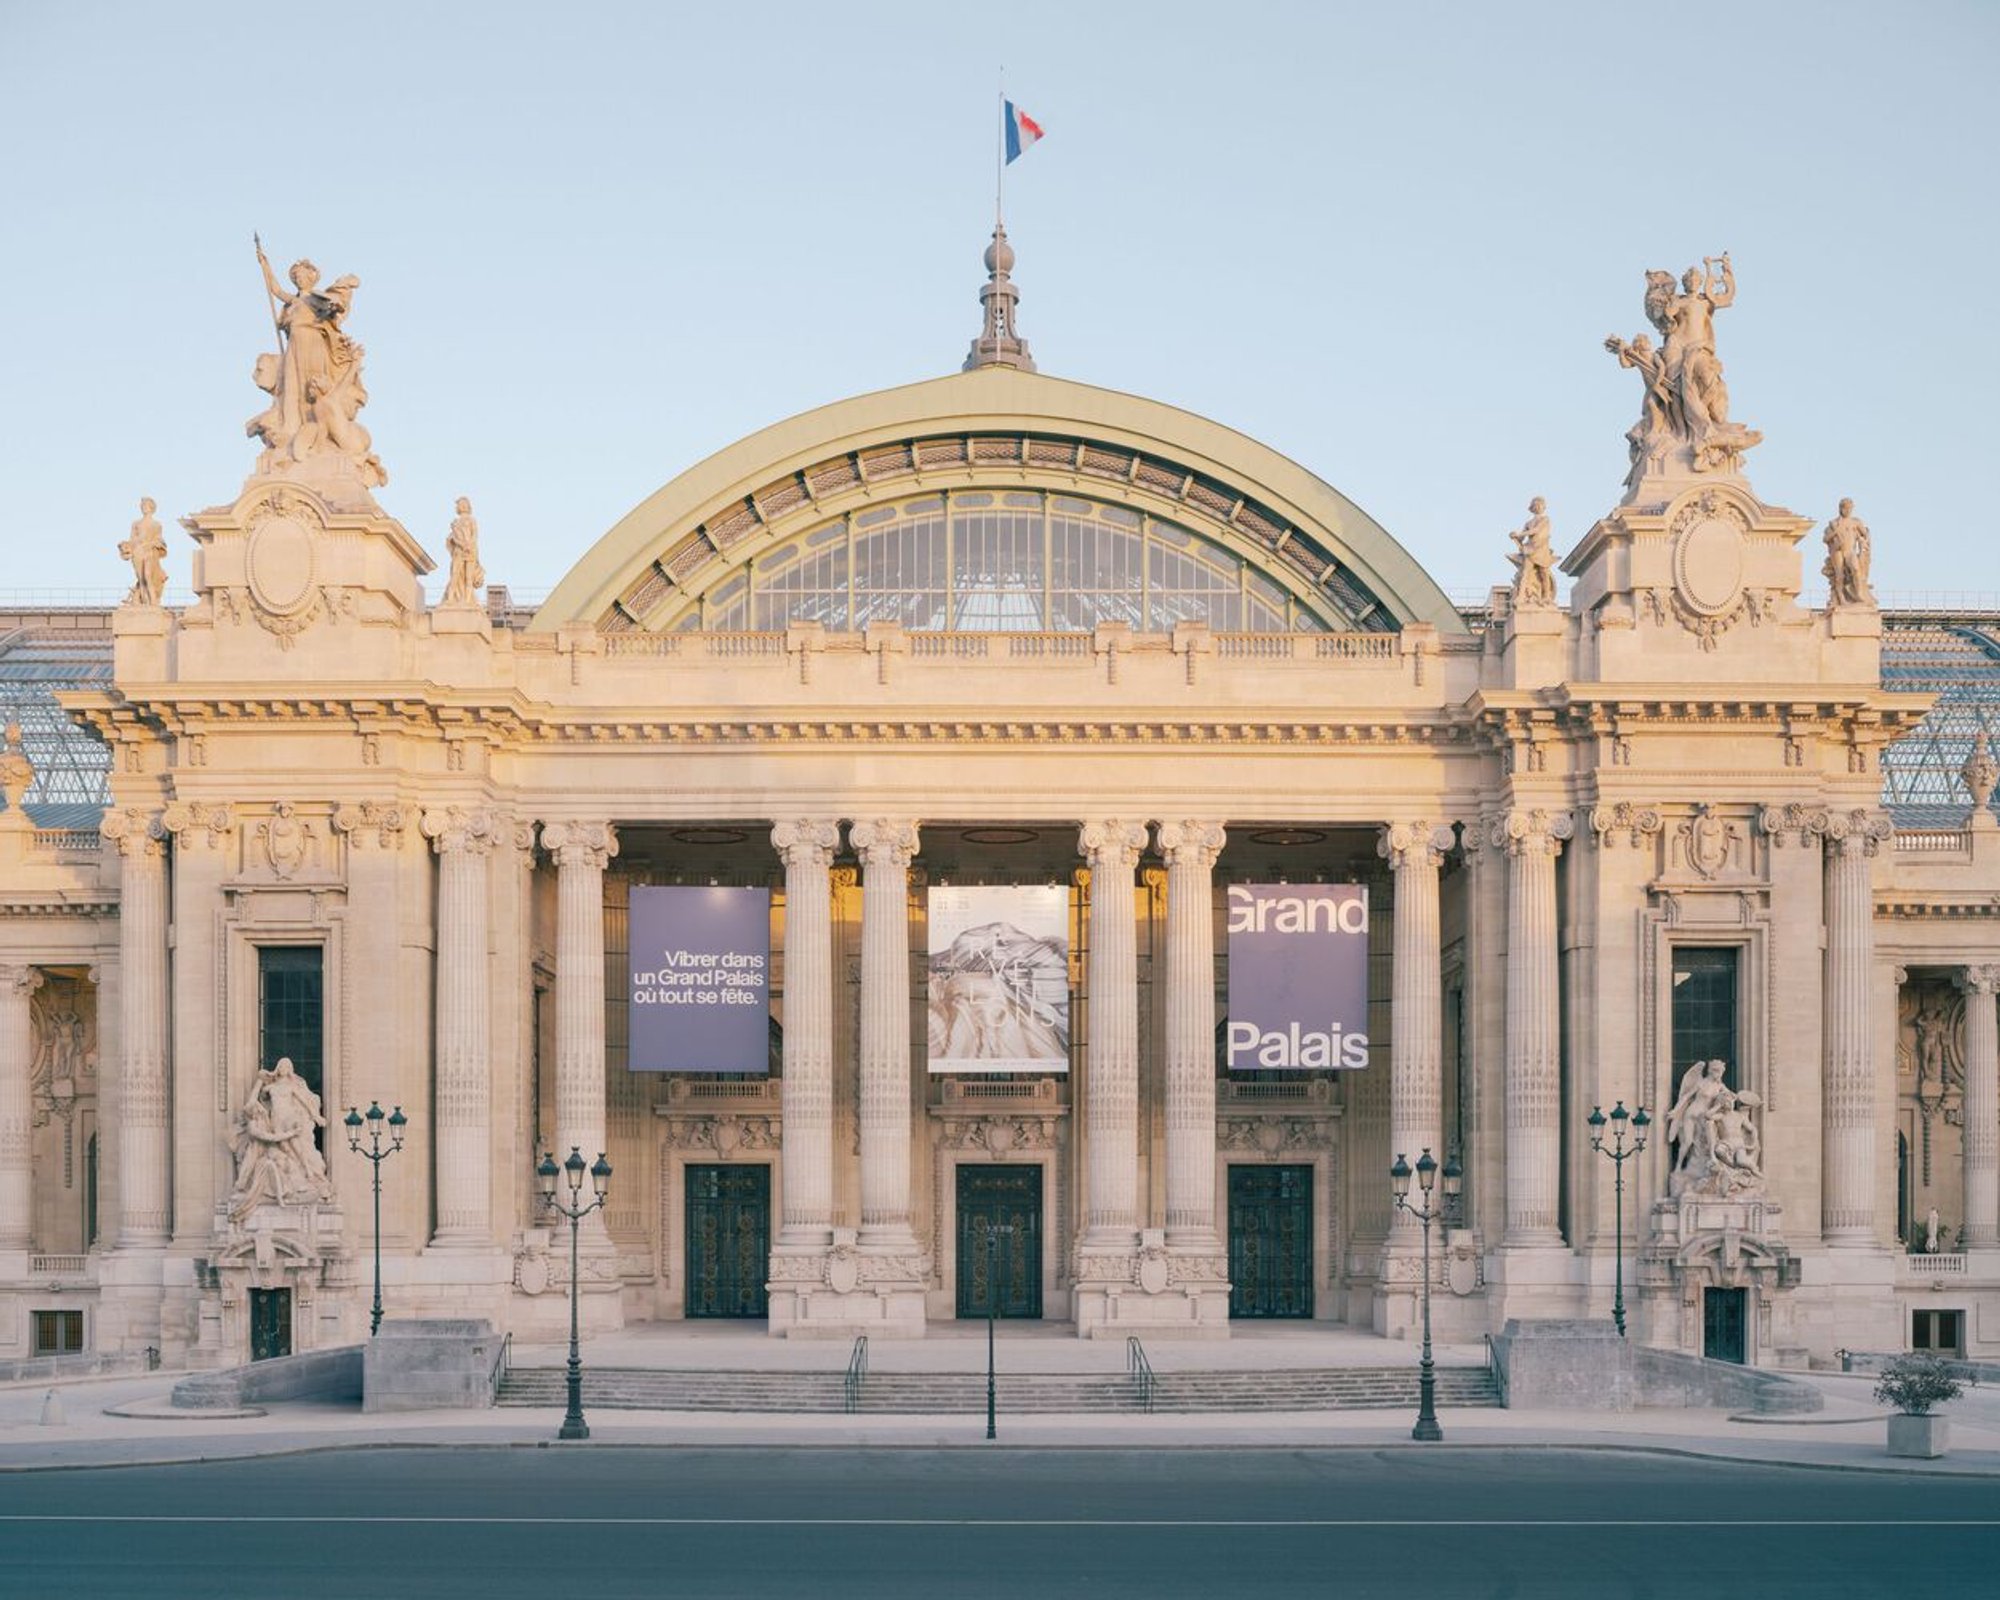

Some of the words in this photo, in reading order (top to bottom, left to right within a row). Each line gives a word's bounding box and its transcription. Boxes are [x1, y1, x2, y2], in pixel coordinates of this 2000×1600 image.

[1228, 886, 1369, 934] Grand
[665, 951, 719, 968] Vibrer
[721, 952, 765, 968] dans
[634, 972, 656, 985] un
[658, 969, 712, 986] Grand
[714, 970, 764, 986] Palais
[633, 987, 657, 1004] où
[659, 988, 694, 1004] tout
[696, 991, 718, 1005] se
[721, 988, 758, 1005] fête.
[1227, 1021, 1370, 1069] Palais
